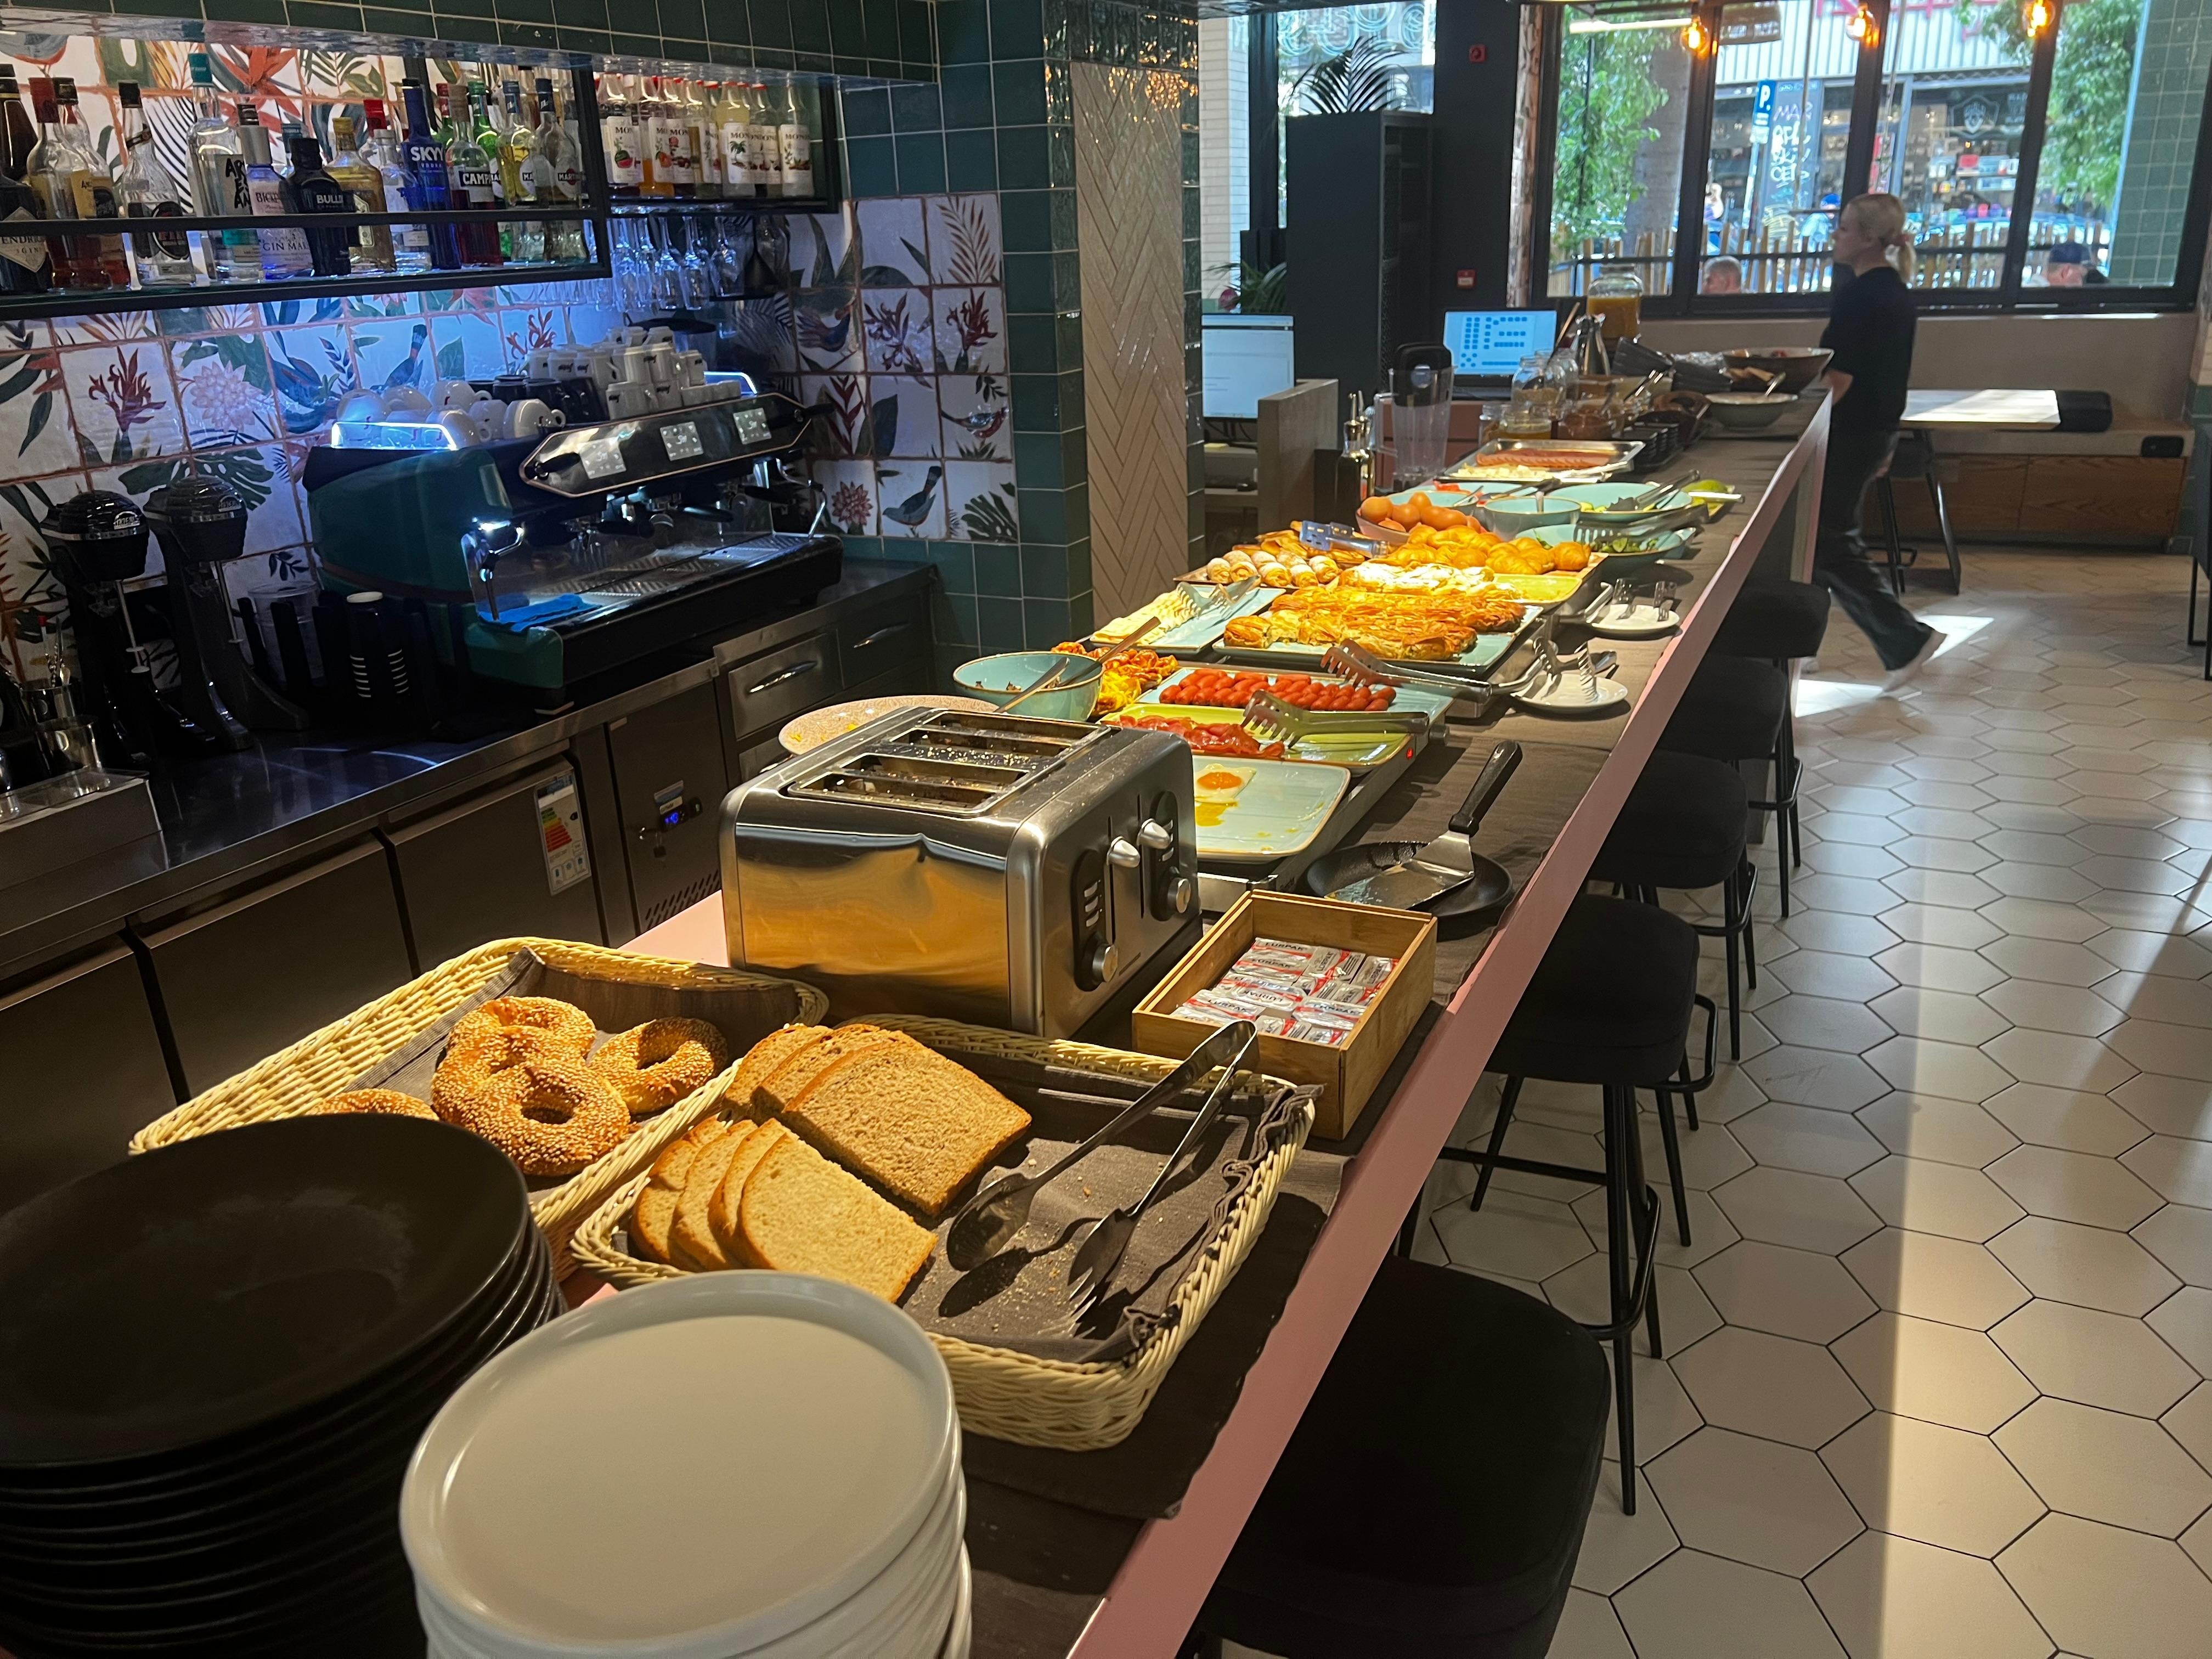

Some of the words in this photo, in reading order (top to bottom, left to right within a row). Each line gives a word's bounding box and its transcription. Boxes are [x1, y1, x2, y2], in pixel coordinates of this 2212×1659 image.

[410, 146, 443, 161] SKYY
[462, 173, 492, 185] CAMP
[263, 242, 284, 251] GIN
[1265, 942, 1306, 951] LURPAK
[1207, 998, 1250, 1012] LURPAK
